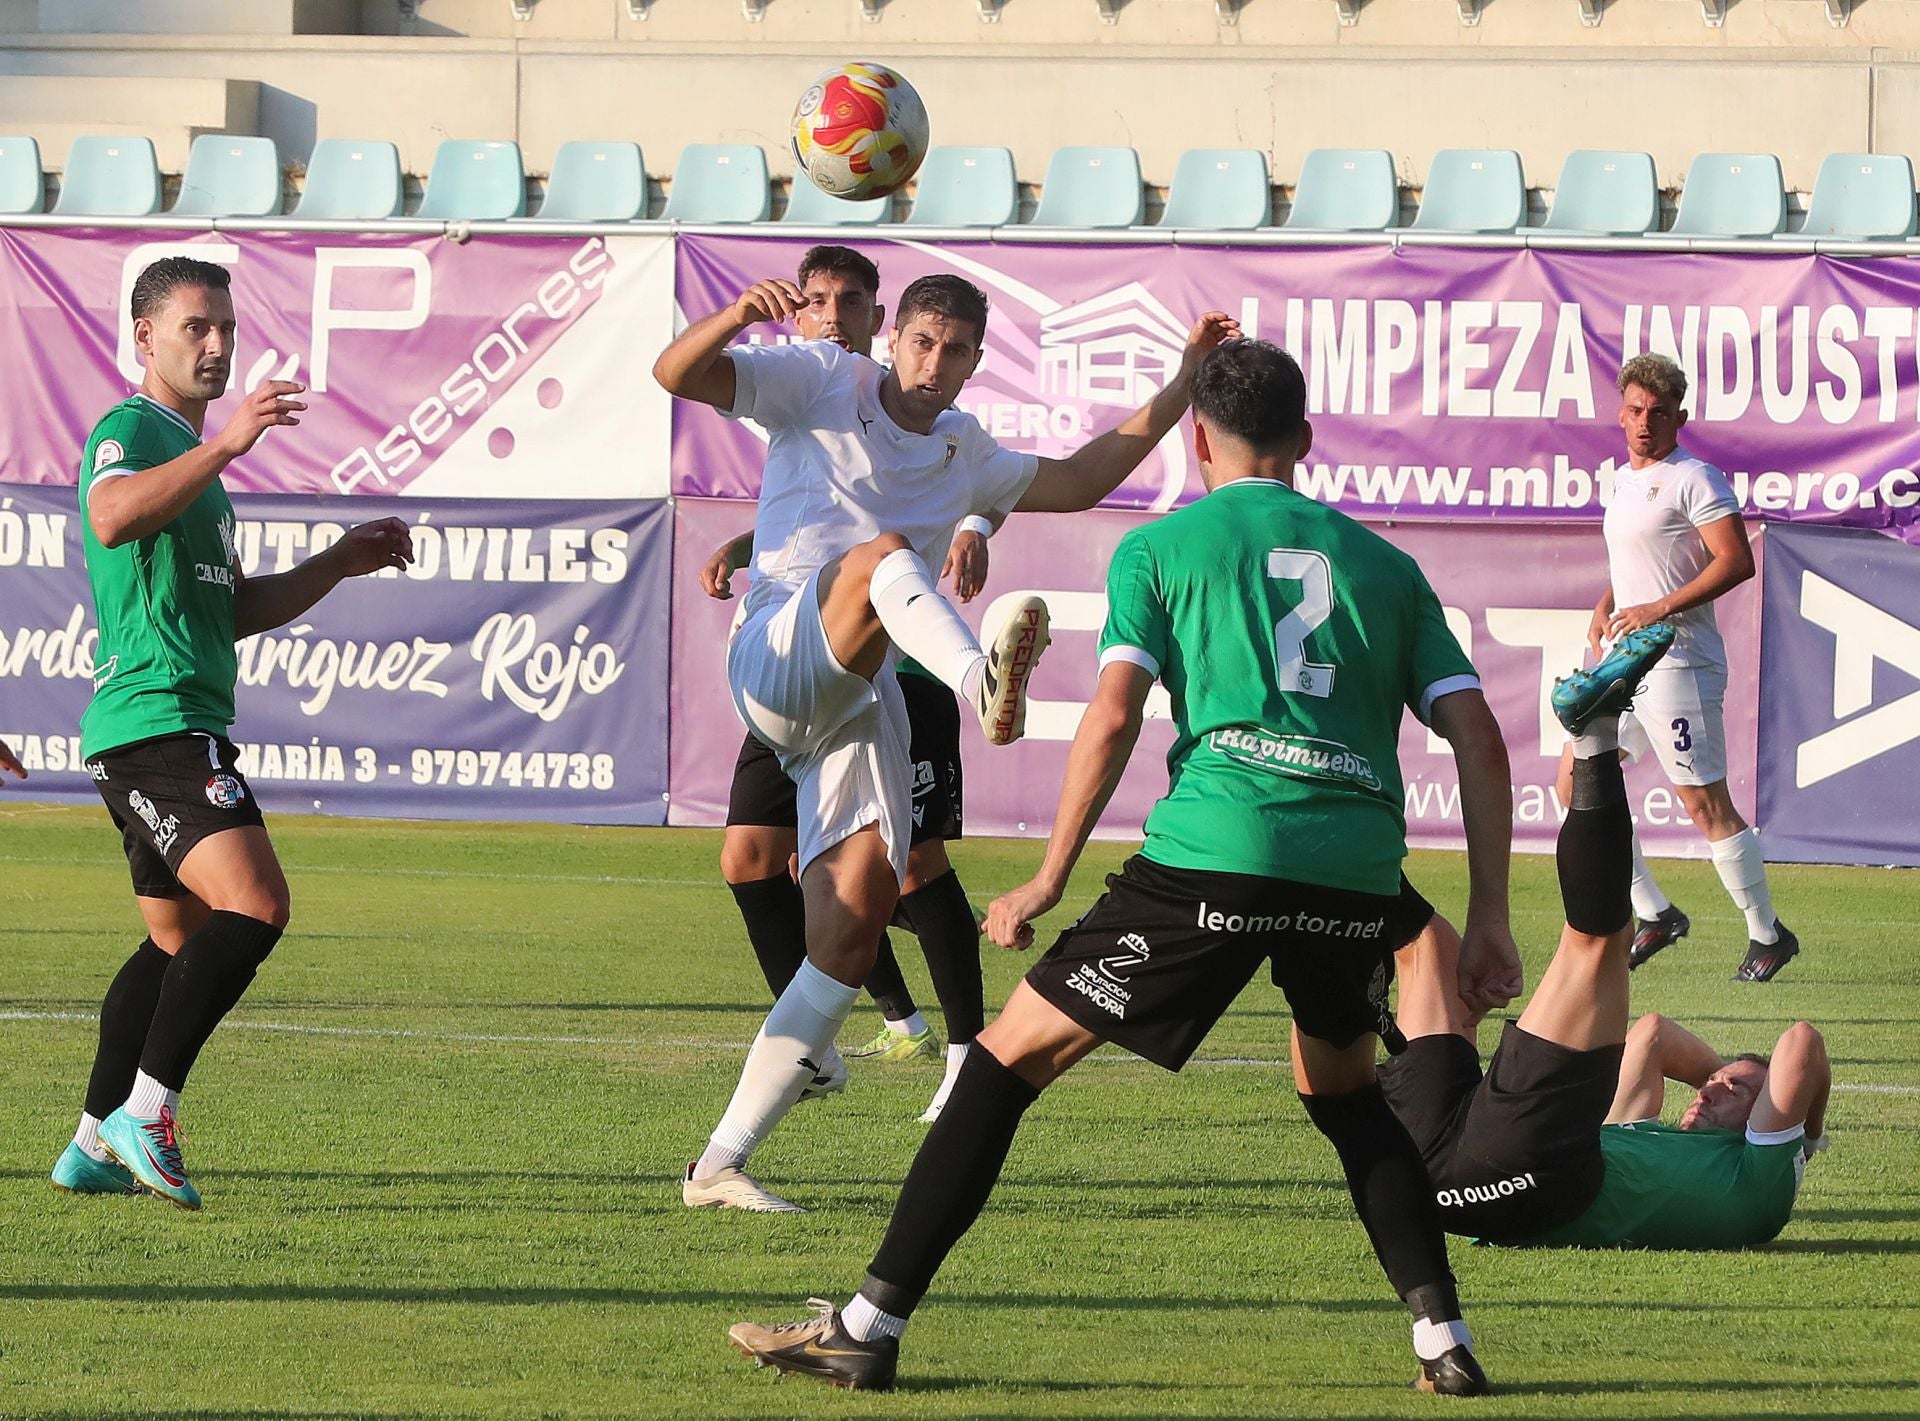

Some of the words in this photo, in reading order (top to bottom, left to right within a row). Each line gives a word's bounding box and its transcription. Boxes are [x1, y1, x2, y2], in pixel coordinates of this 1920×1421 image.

[330, 237, 607, 495] Asesores
[1267, 548, 1337, 698] 2
[470, 611, 625, 722] Rojo
[1671, 717, 1693, 752] 3
[355, 747, 377, 783] 3
[411, 748, 615, 791] 979744738
[1197, 901, 1385, 939] leomotor.net
[1065, 972, 1125, 1020] ZAMORA
